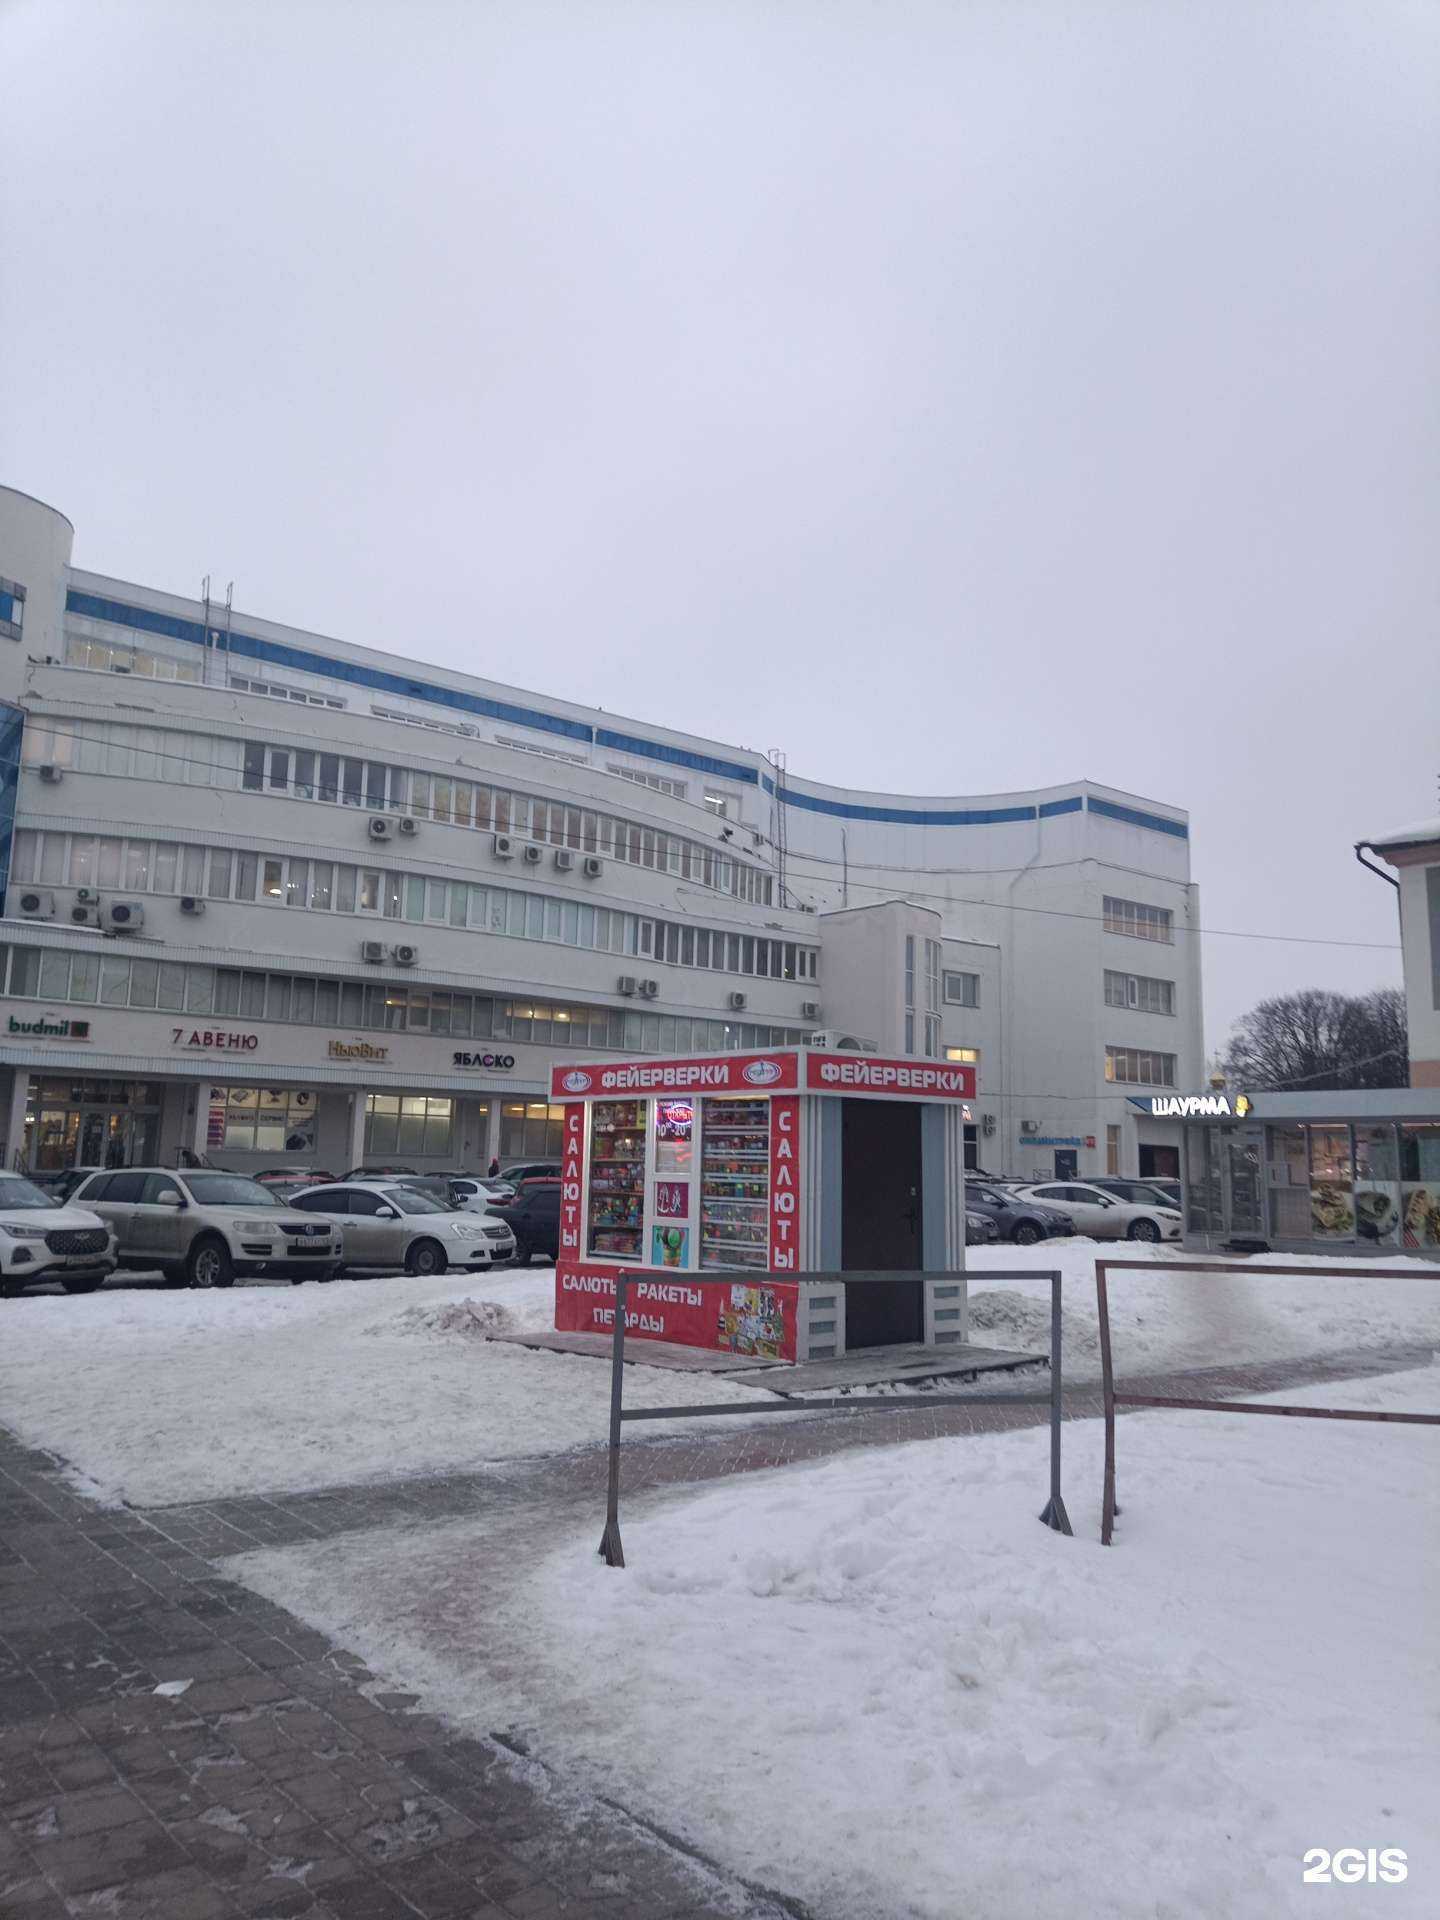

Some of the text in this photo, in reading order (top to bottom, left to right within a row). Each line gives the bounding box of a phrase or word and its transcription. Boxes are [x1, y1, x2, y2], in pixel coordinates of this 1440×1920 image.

[8, 1015, 70, 1036] budmil
[172, 1028, 259, 1050] 7 АВЕНЮ
[453, 1052, 515, 1069] ЯБЛОКО
[601, 1065, 729, 1089] ФЕЙЕРВЕРКИ
[820, 1059, 965, 1092] ФЕЙЕРВЕРКИ
[1151, 1096, 1231, 1117] ШАУРМА
[561, 1114, 580, 1247] САЛЮТЫ
[773, 1111, 795, 1269] САЛЮТЫ
[637, 1282, 703, 1306] РАКЕТЫ
